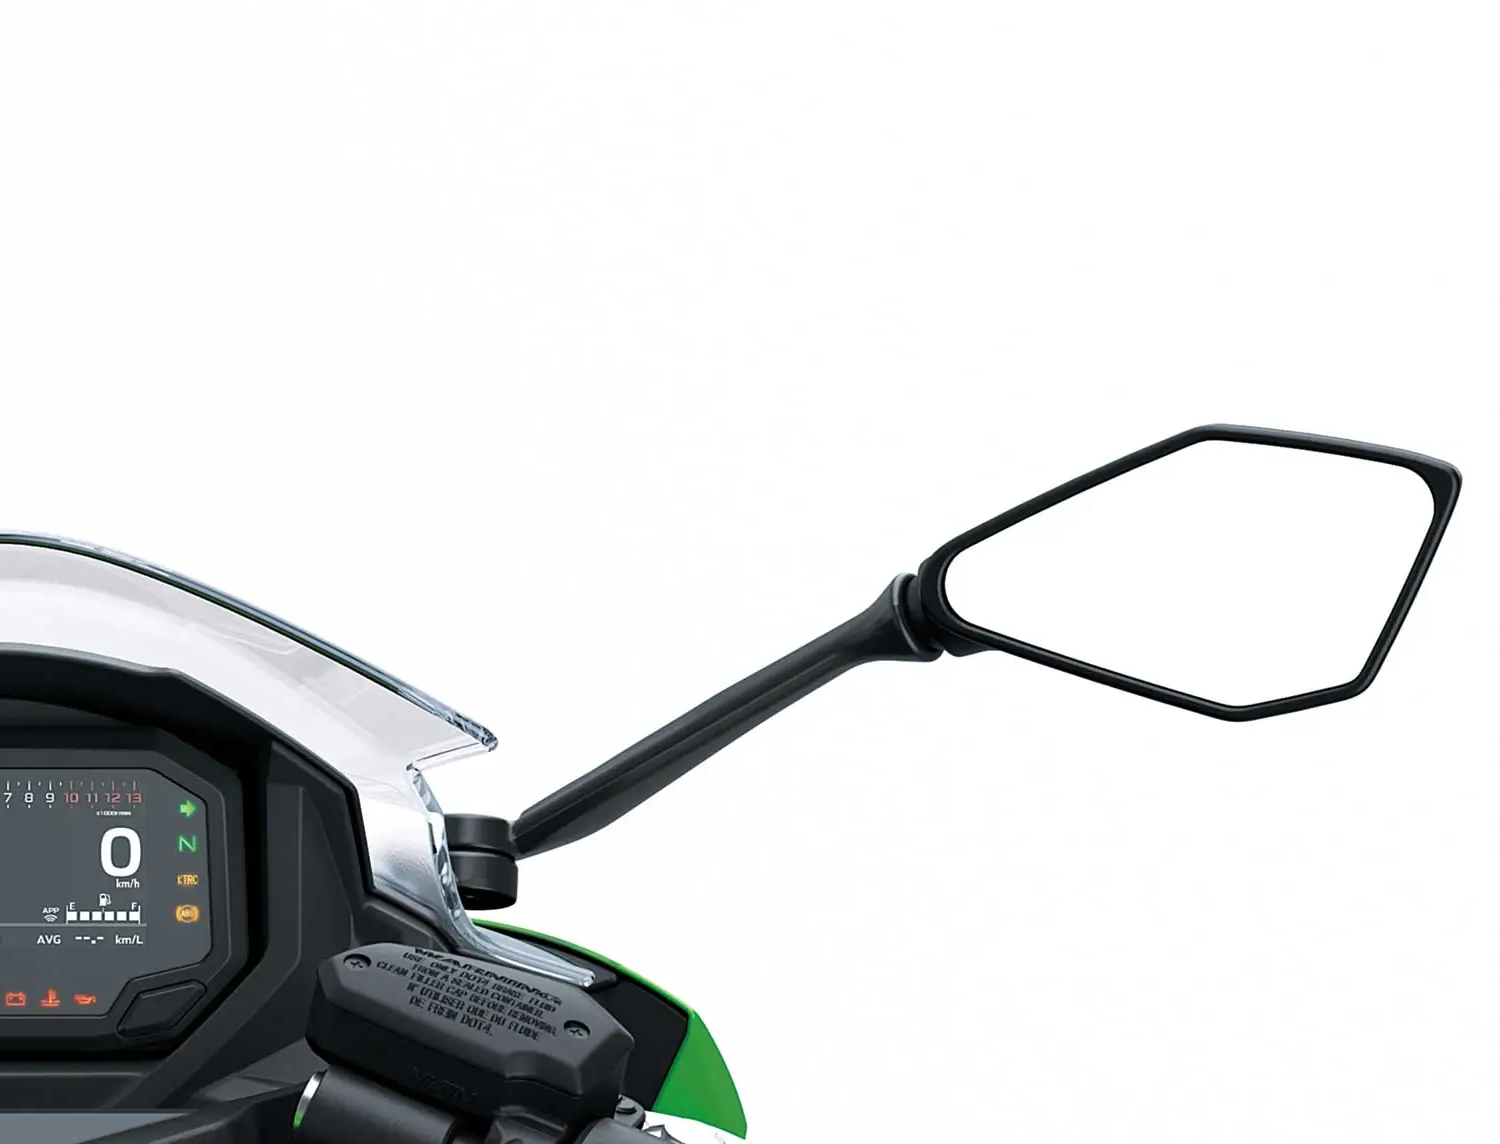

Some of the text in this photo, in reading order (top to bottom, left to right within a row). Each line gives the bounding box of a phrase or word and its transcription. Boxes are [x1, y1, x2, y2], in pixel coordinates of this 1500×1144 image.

[3, 792, 12, 803] 7
[24, 792, 33, 803] 8
[45, 792, 55, 803] 9
[64, 792, 79, 803] 10
[86, 792, 98, 803] 11
[105, 792, 120, 803] 12
[126, 792, 142, 803] 13
[178, 836, 197, 852] N
[100, 827, 141, 877] 0
[116, 878, 140, 889] km/h
[177, 874, 199, 885] KTRC
[69, 902, 76, 910] E
[37, 935, 61, 945] AVG
[115, 934, 143, 945] km/L
[376, 961, 409, 976] CLEAN
[430, 961, 458, 974] ONLY
